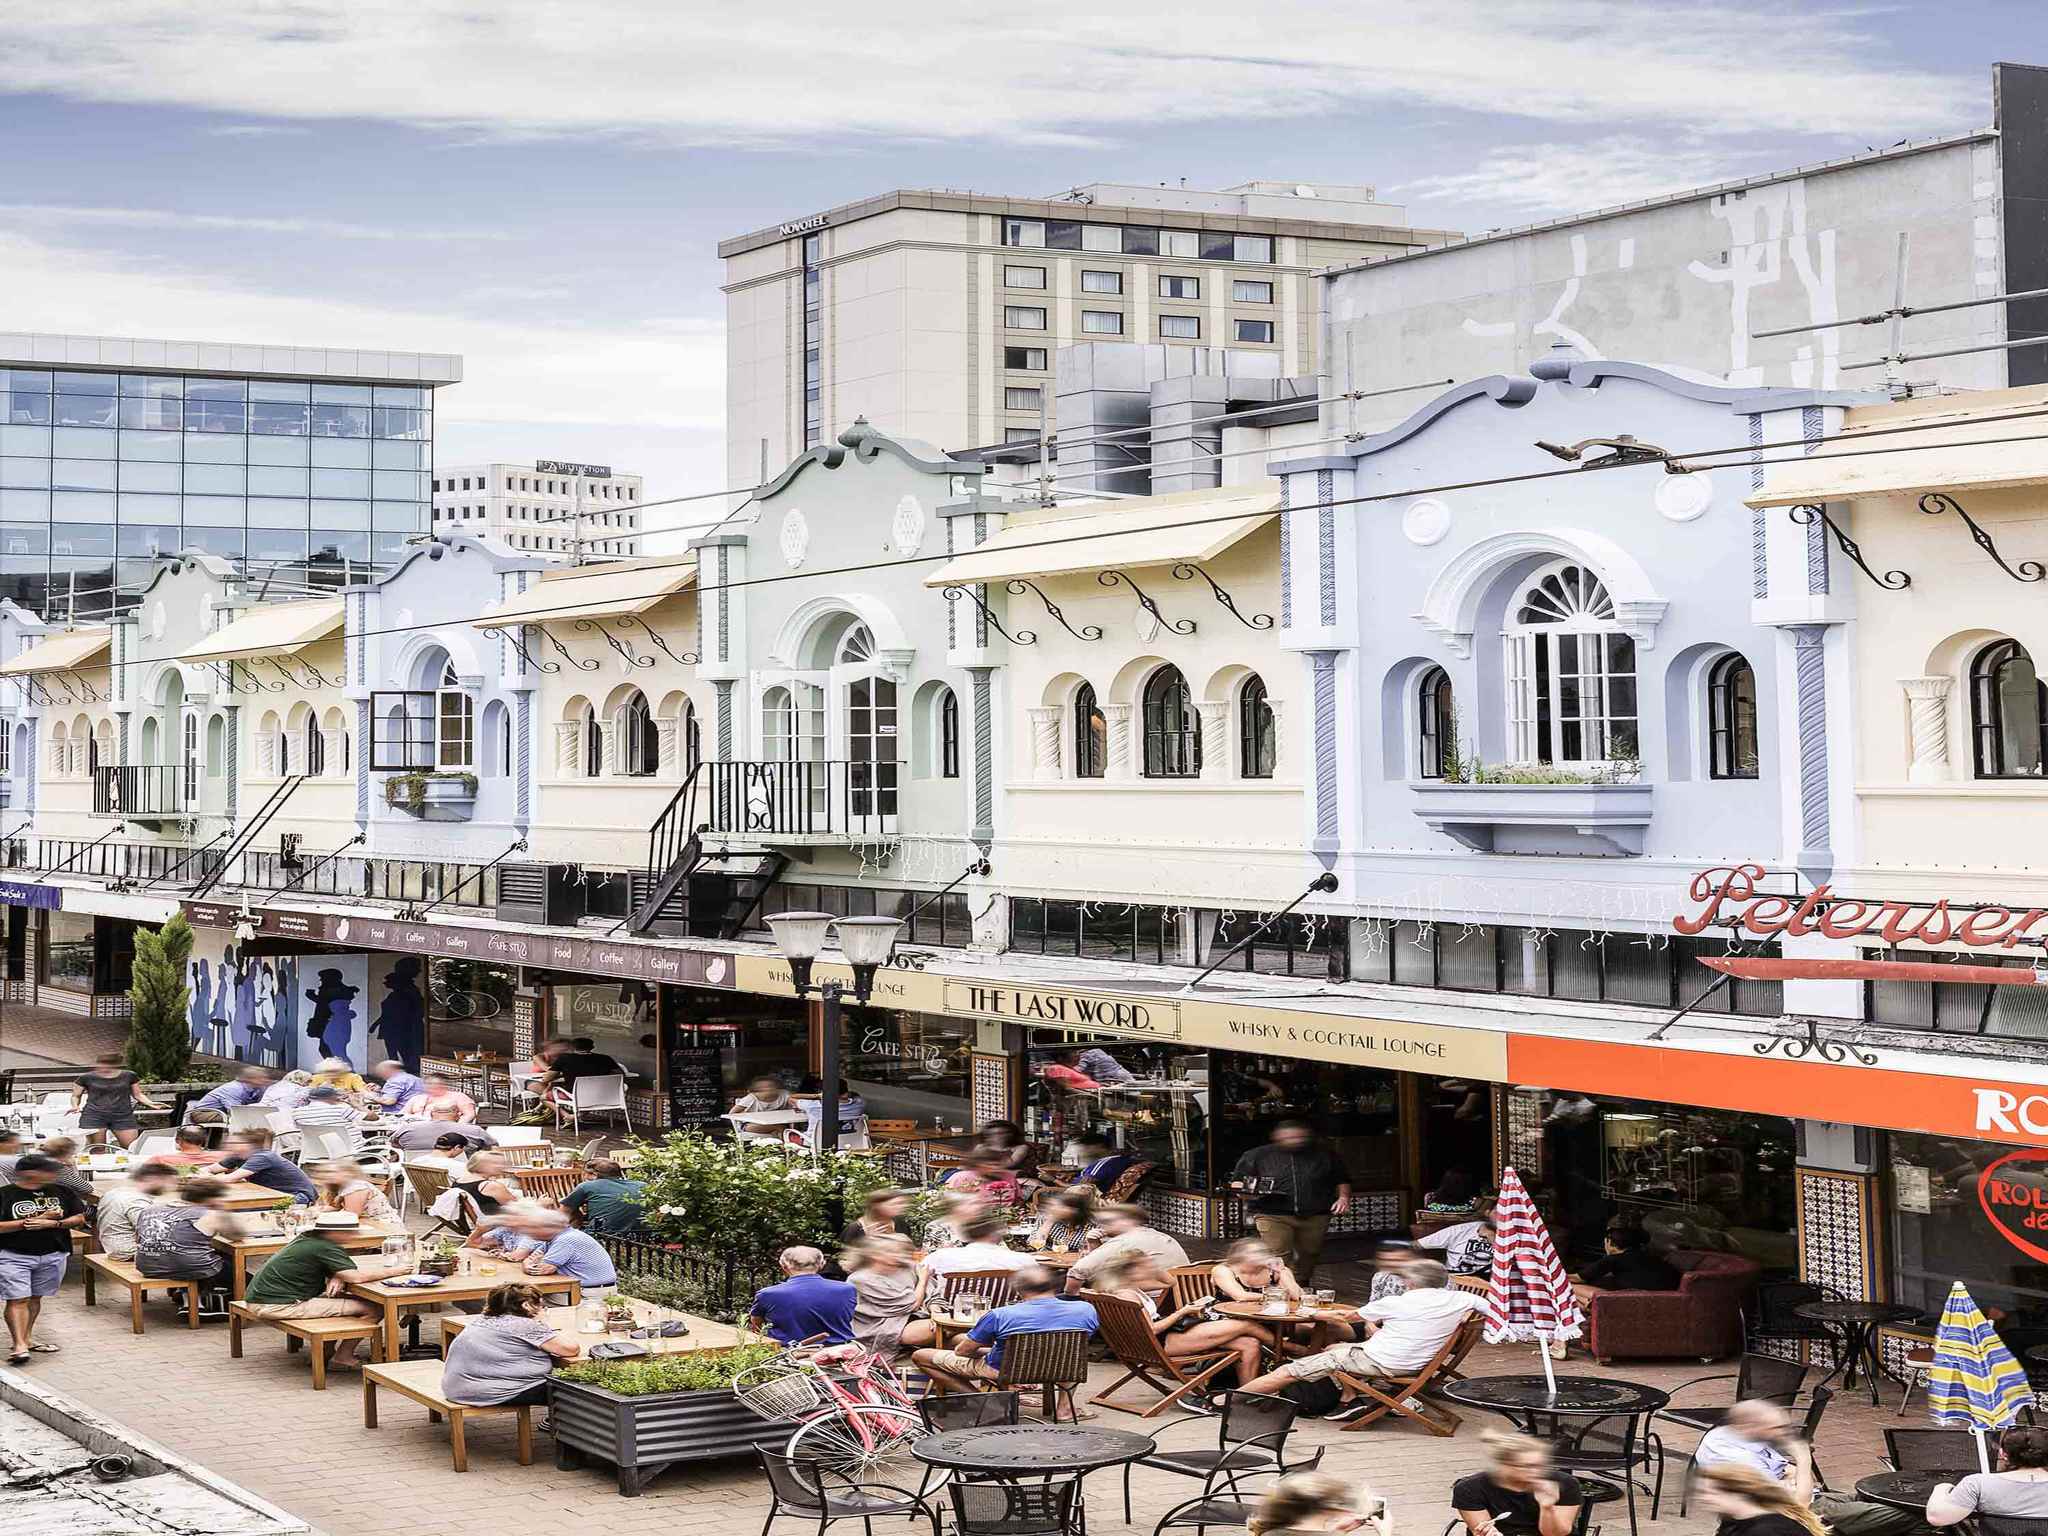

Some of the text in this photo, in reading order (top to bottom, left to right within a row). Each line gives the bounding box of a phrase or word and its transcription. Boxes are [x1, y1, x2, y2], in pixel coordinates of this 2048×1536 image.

[780, 216, 826, 235] NOVOTEL
[371, 928, 468, 950] Food Coffee Gallery
[554, 947, 680, 973] Food Coffee Gallery
[967, 986, 1155, 1031] THE LAST WORD.
[1228, 1020, 1448, 1058] WHISKY & COCKTAIL LOUNGE
